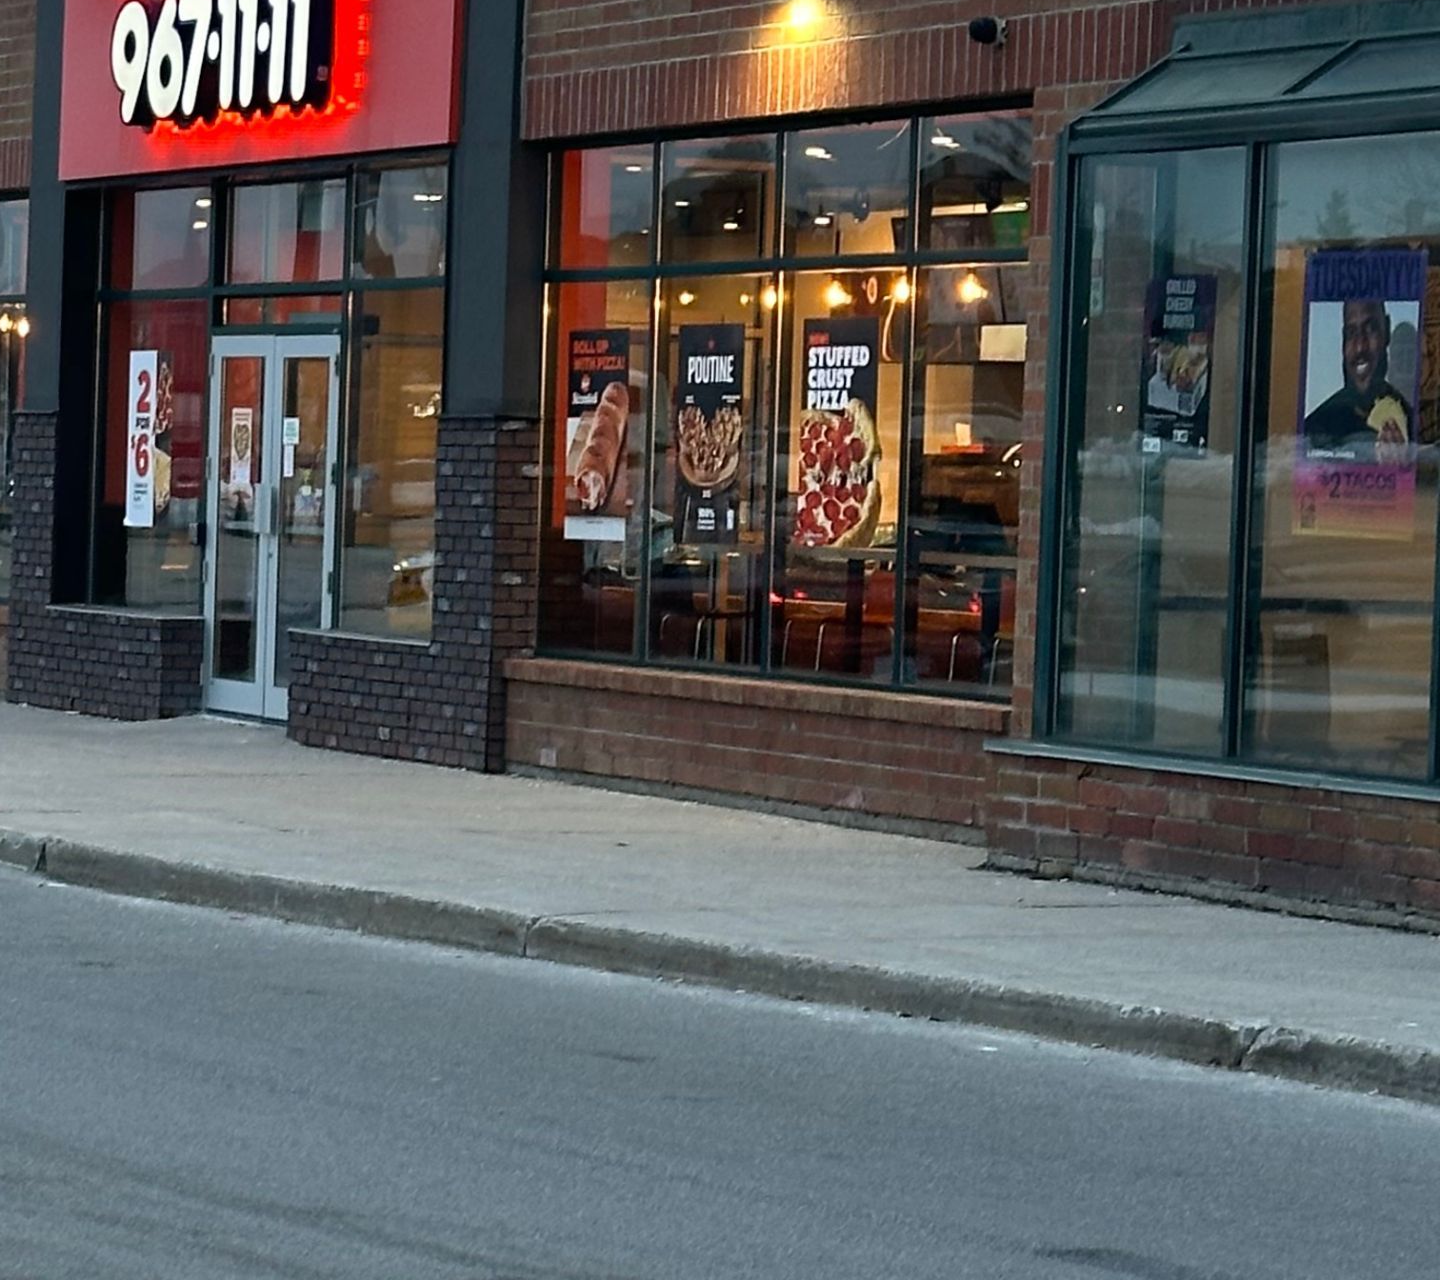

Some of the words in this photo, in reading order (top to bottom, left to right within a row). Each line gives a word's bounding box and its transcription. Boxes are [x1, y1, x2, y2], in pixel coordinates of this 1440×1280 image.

[808, 345, 870, 368] STUFFED
[687, 354, 735, 384] POUTINE
[807, 368, 855, 389] CRUST
[137, 369, 151, 414] 2
[807, 389, 850, 411] PIZZA
